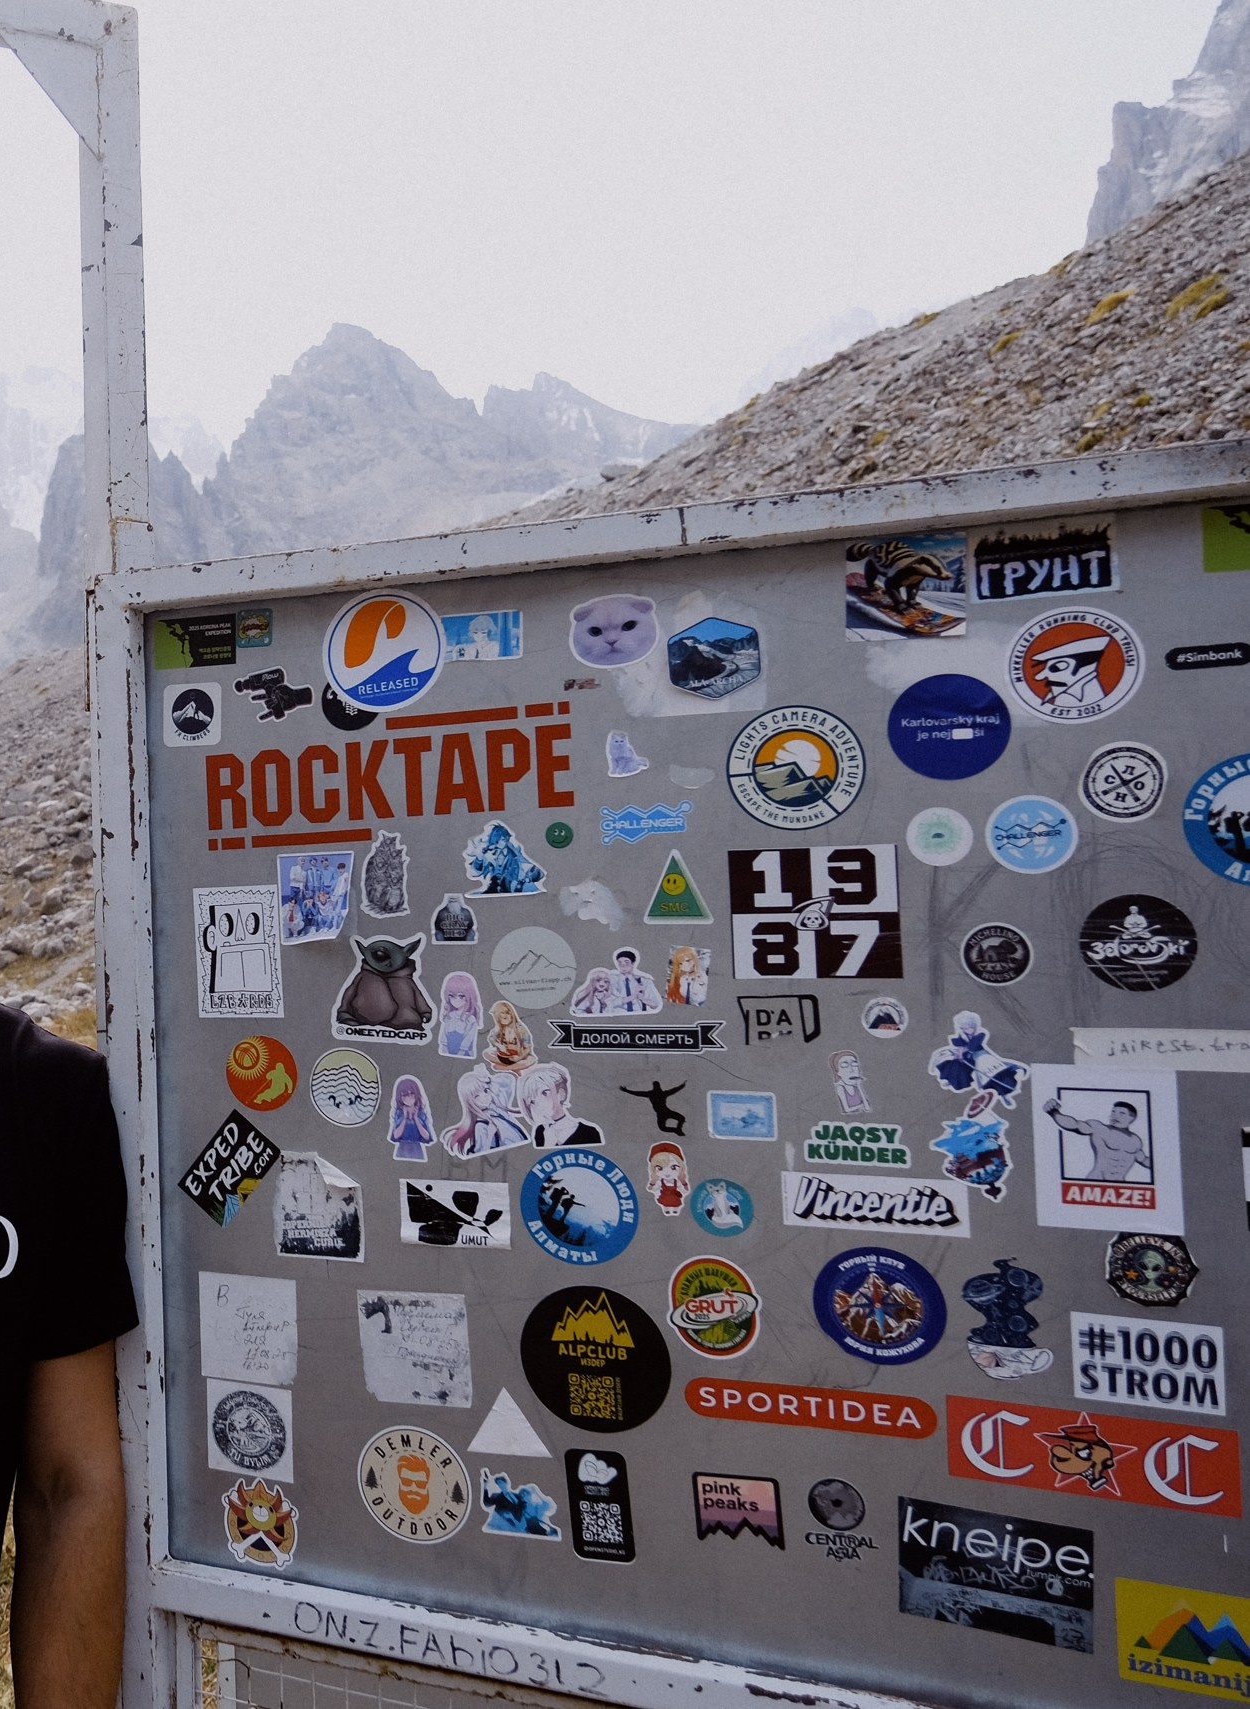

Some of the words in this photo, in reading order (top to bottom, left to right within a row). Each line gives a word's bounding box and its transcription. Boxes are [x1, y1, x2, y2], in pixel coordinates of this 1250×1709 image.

[979, 550, 1107, 597] ГРУНТ
[1038, 614, 1087, 631] RUNNING
[1176, 648, 1243, 663] #Simbank
[358, 676, 419, 695] RELEASED
[975, 713, 1000, 725] kraj
[1050, 707, 1072, 716] EST
[1077, 704, 1102, 717] 2022
[916, 730, 929, 741] je
[734, 721, 768, 760] LIGHTS
[772, 711, 827, 727] CAMERA
[829, 724, 860, 797] ADVENTURE
[205, 723, 575, 830] ROCKTAPE
[737, 783, 763, 812] ESCAPE
[763, 809, 779, 821] THE
[782, 810, 825, 823] MUNDANE
[603, 817, 683, 830] CHALLENGER
[995, 829, 1062, 842] CHALLENGER
[659, 901, 690, 913] SMC
[982, 970, 1016, 981] HOUSE
[336, 1026, 428, 1041] @ONEEYEDCAPP
[580, 1031, 631, 1046] ДОЛОЙ
[635, 1033, 694, 1046] СМЕРТЬ
[815, 1125, 899, 1145] JAQSY
[185, 1122, 239, 1197] EXPED
[808, 1141, 908, 1165] KÜNDER
[209, 1131, 264, 1201] TRIBE
[532, 1153, 606, 1179] Горные
[607, 1168, 635, 1223] Люди
[1066, 1185, 1152, 1206] AMAZE!
[461, 1234, 489, 1247] UMUT
[527, 1220, 598, 1263] Алматы
[838, 1254, 877, 1271] ГОРНЫЙ
[879, 1255, 906, 1270] КЛУБ
[558, 1343, 628, 1361] ALPCLUB
[1078, 1322, 1218, 1371] #1000
[1078, 1364, 1220, 1409] STROM
[699, 1386, 921, 1429] SPORTIDEA
[374, 1434, 453, 1469] DEMLER
[702, 1481, 742, 1497] pink
[703, 1498, 760, 1513] peaks
[372, 1497, 458, 1536] OUTDOOR
[826, 1546, 862, 1562] ASIA
